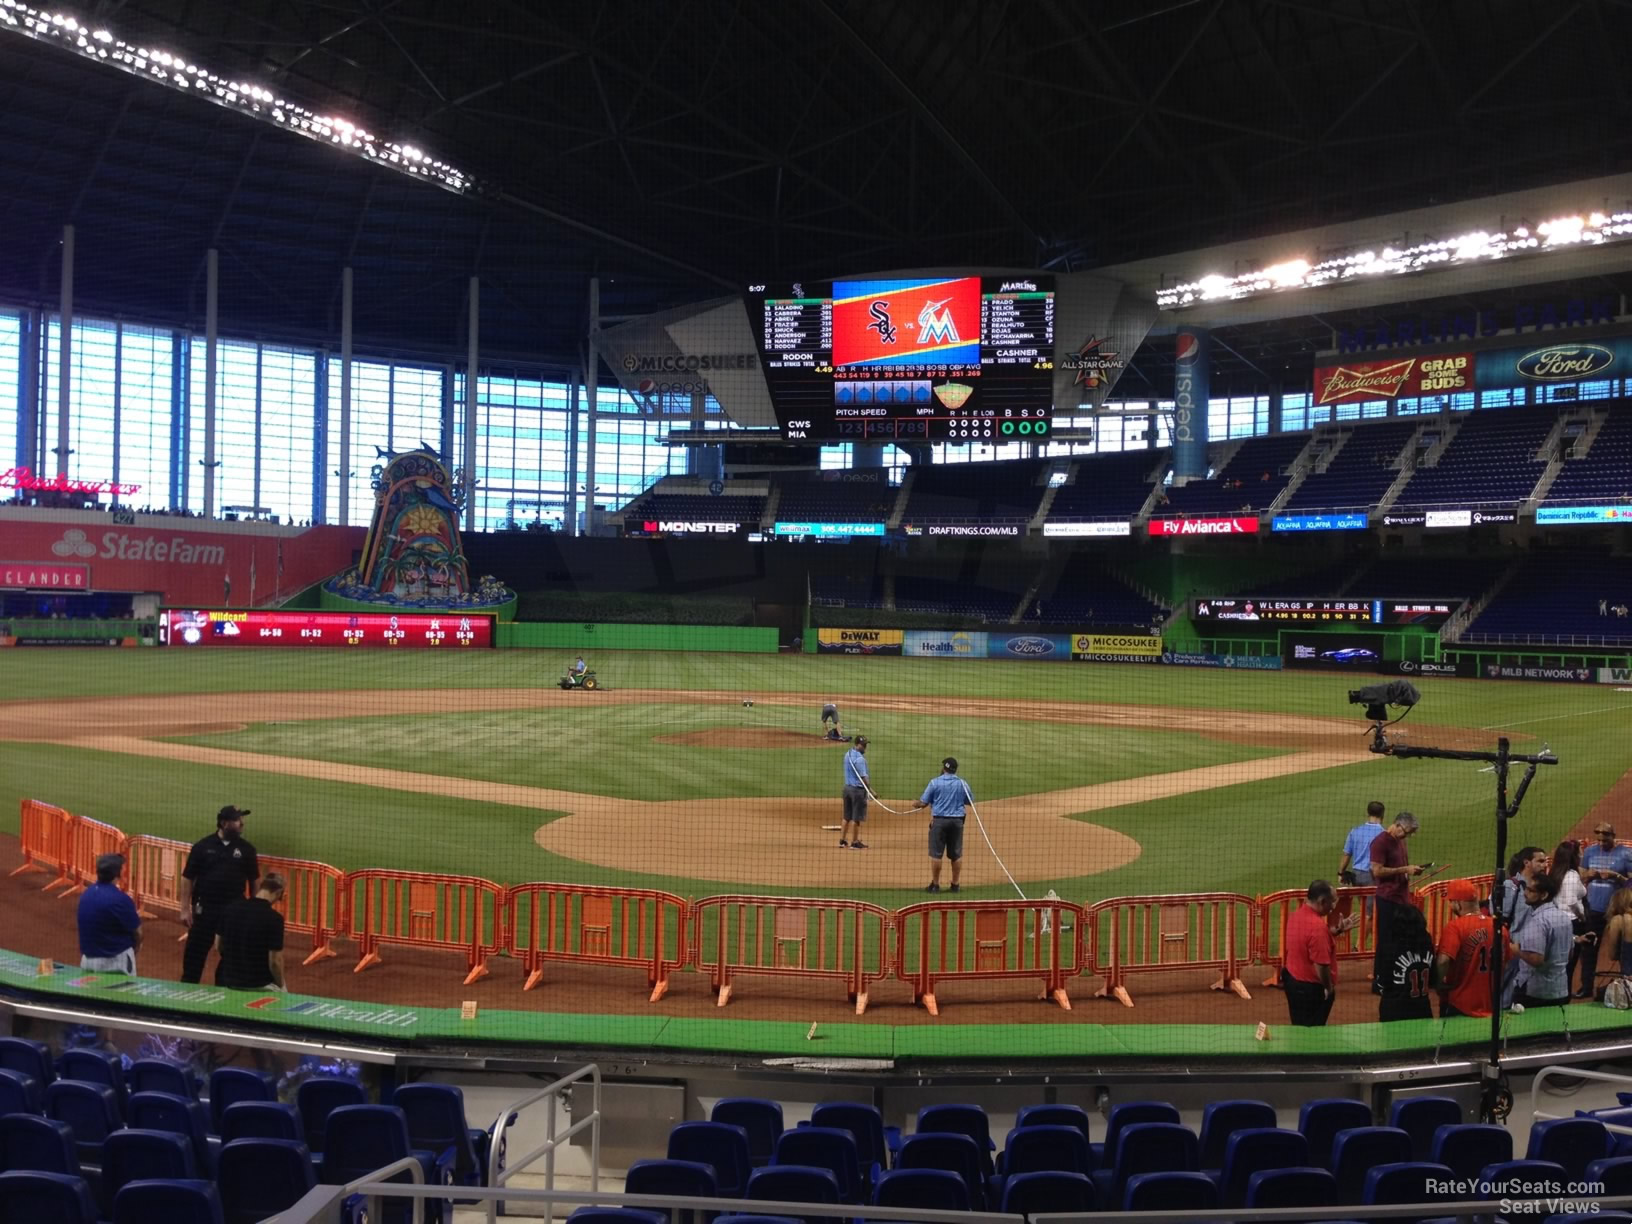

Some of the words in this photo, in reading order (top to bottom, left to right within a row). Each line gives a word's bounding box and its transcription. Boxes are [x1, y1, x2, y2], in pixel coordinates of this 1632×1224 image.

[1000, 280, 1036, 292] MARLINS
[1340, 310, 1500, 352] MARLINS
[1515, 297, 1616, 334] PARK
[641, 354, 757, 371] MICCOSUKEE
[1099, 360, 1124, 368] GAME
[1420, 356, 1467, 373] GRAB
[1534, 348, 1594, 375] Ford
[1428, 369, 1458, 379] SOME
[658, 379, 708, 394] pepsi
[1321, 371, 1410, 392] Budweiser
[1420, 376, 1466, 390] BUDS
[1555, 388, 1576, 398] 448
[1176, 372, 1195, 442] pepsi
[114, 514, 133, 523] 427
[1572, 511, 1598, 519] Republic
[659, 522, 736, 532] MONSTER
[929, 527, 1018, 535] DRAFTKINGS.COM/MLB
[1164, 522, 1179, 534] Fly
[1182, 520, 1231, 534] Avianca
[209, 612, 248, 622] Wildcard
[1015, 640, 1045, 652] Ford
[1093, 638, 1157, 647] MICCOSUKEE
[1080, 654, 1157, 662] #MICCOSUKEELIFE
[1415, 664, 1456, 672] LEXUS
[1502, 668, 1522, 676] MLB
[1524, 668, 1574, 679] NETWORK
[1410, 968, 1430, 997] 11
[314, 1001, 418, 1027] Health
